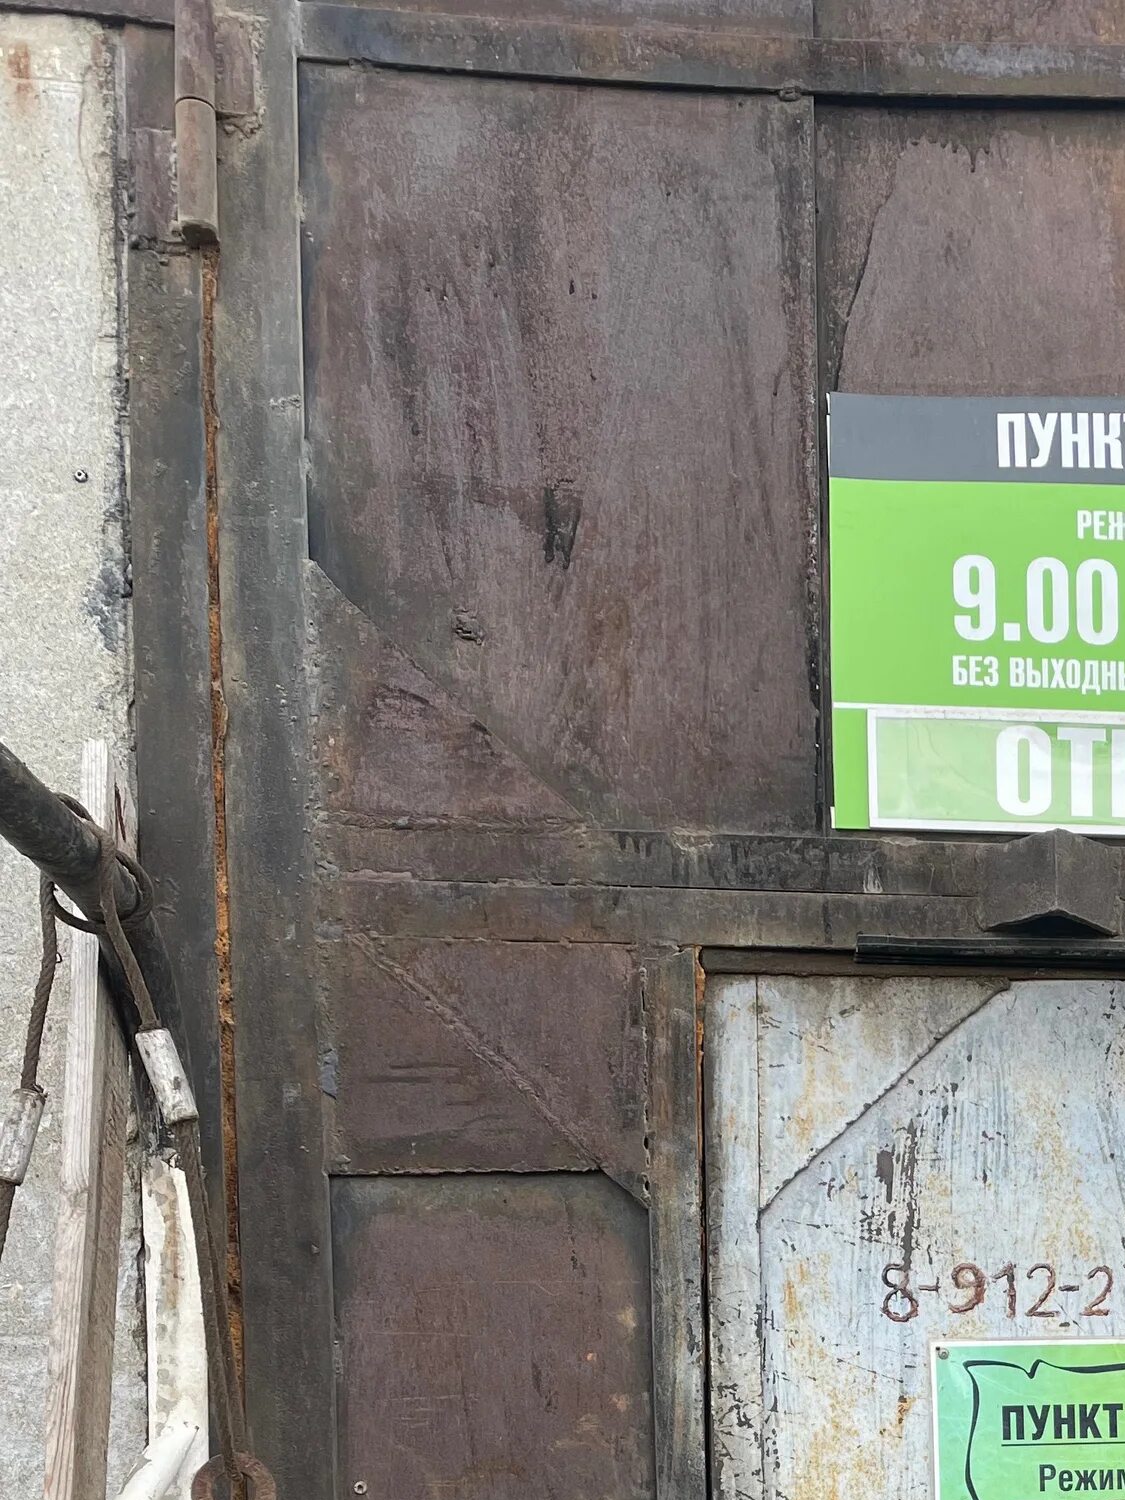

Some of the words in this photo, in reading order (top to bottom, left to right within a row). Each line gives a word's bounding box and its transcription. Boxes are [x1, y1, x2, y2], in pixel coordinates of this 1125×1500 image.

[952, 554, 1119, 646] 9.00
[952, 655, 1000, 687] БЕЗ
[1001, 1403, 1124, 1441] ПУНКТ
